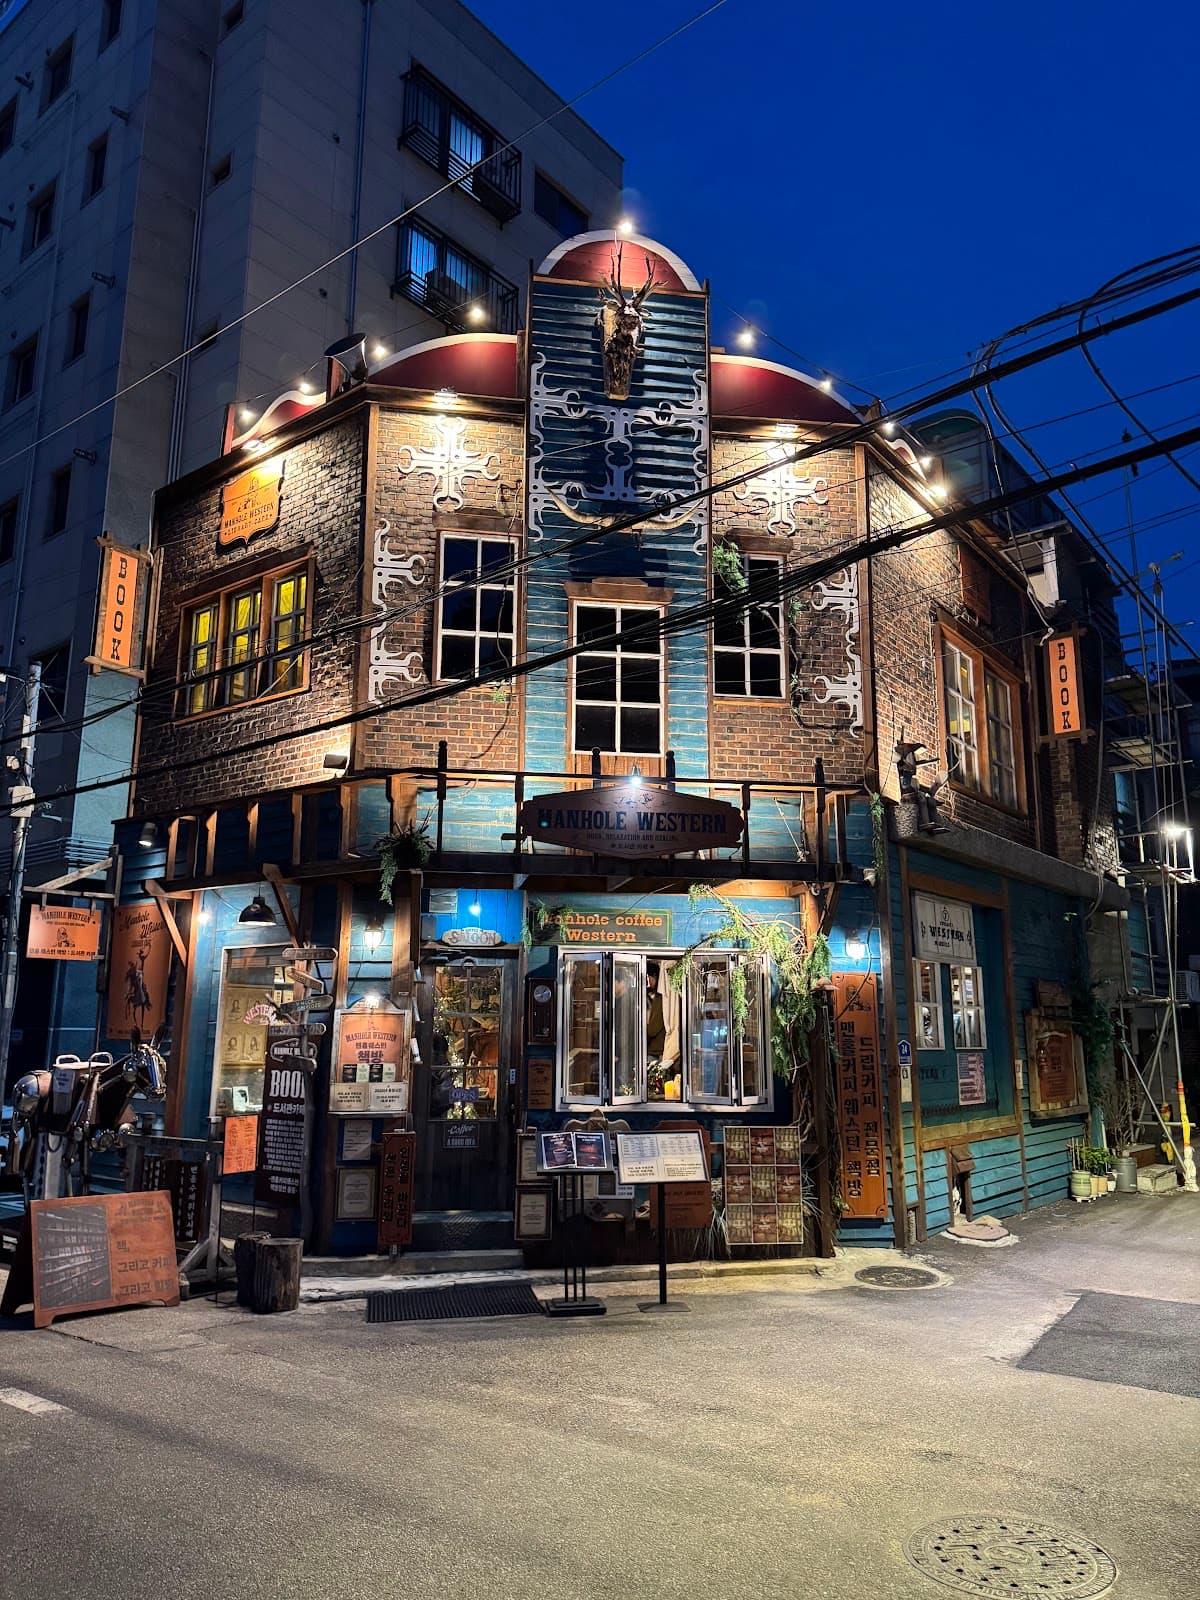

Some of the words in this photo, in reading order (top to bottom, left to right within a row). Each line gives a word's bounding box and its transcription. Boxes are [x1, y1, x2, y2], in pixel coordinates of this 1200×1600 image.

[110, 556, 128, 661] BOOK
[1057, 642, 1072, 730] BOOK
[538, 809, 628, 831] MANHOLE
[636, 811, 726, 834] WESTERN
[615, 912, 663, 927] coffee
[566, 928, 636, 943] Western
[358, 1050, 384, 1064] 책방
[841, 1021, 858, 1092] 맨홀커피
[860, 1036, 877, 1108] 드립커피
[451, 1088, 476, 1100] OPEN
[448, 1122, 476, 1136] Coffee
[117, 1259, 150, 1273] 그리고
[119, 1282, 152, 1297] 그리고
